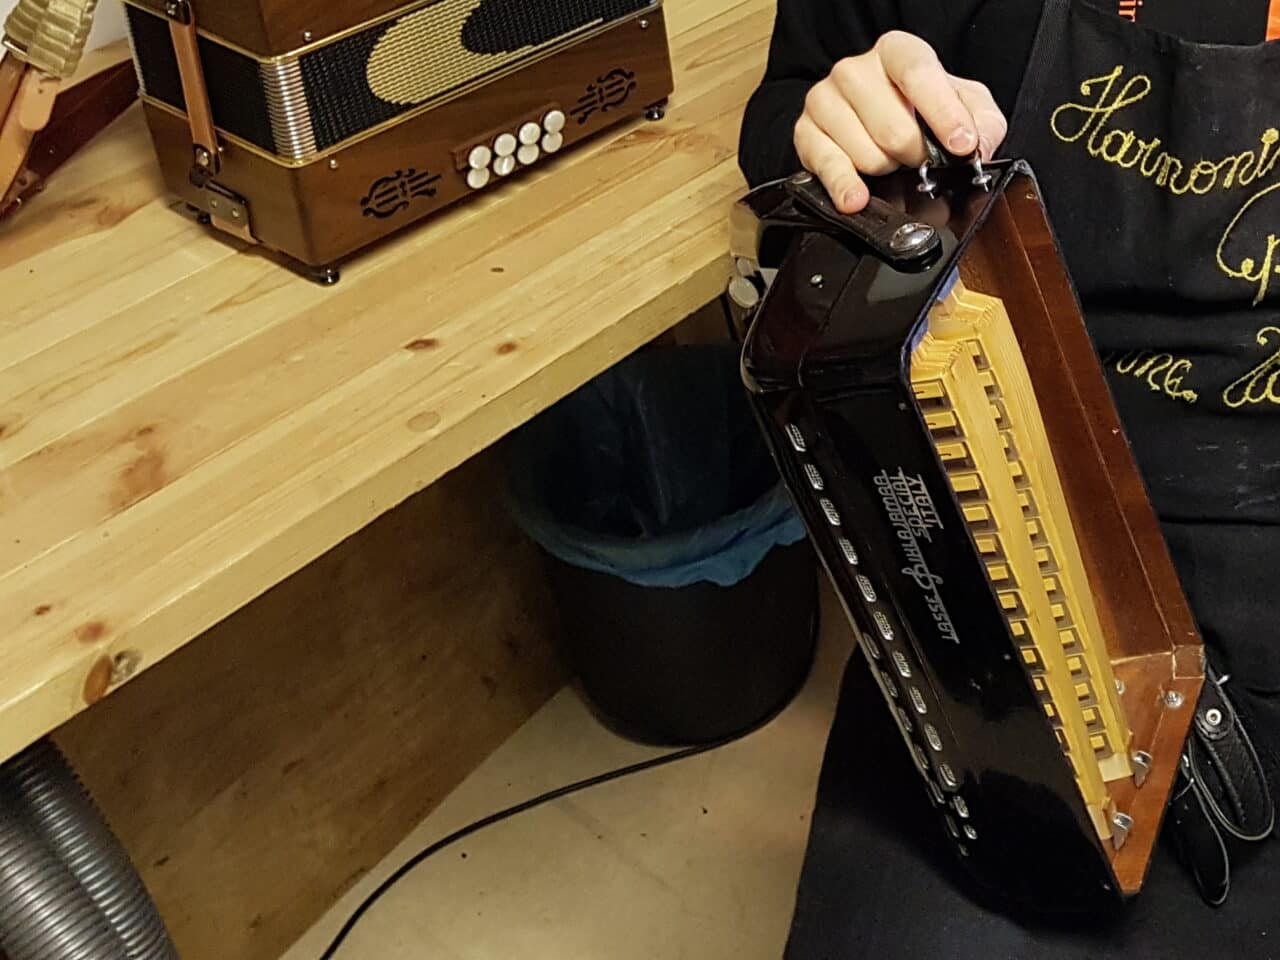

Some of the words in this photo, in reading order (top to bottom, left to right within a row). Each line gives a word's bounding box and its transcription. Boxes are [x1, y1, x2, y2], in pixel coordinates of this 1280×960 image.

[892, 466, 933, 543] SPECIAL
[906, 474, 944, 530] ITALY
[925, 594, 960, 644] LASSE
